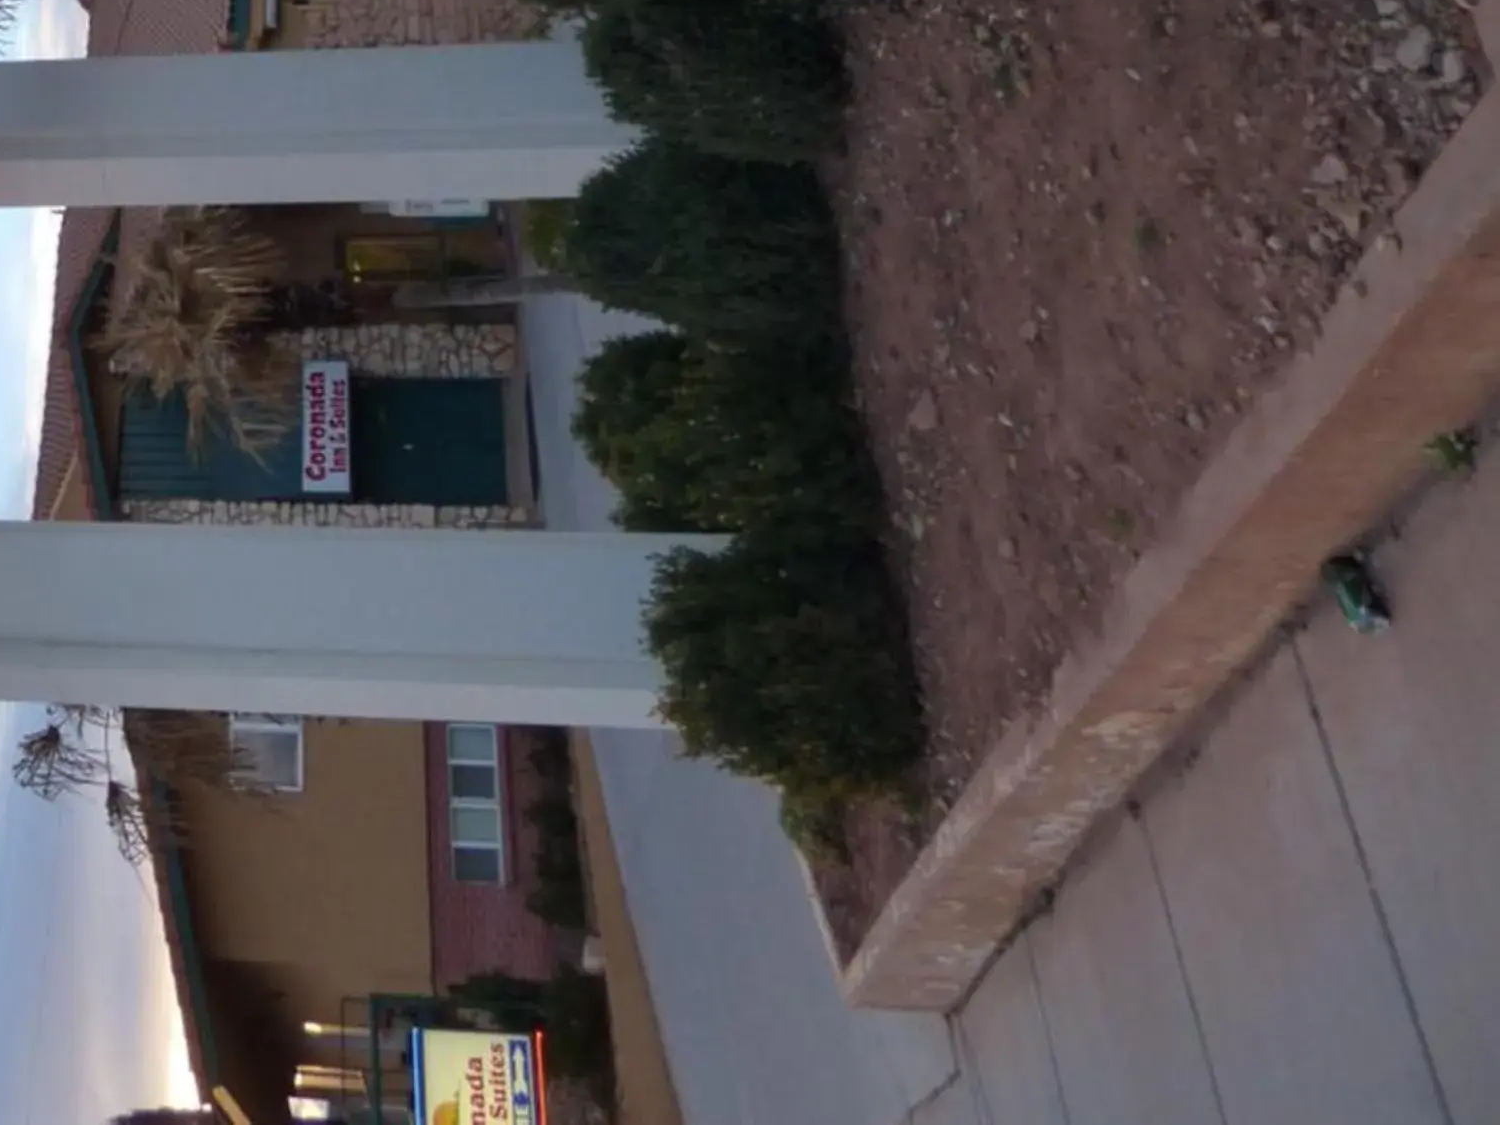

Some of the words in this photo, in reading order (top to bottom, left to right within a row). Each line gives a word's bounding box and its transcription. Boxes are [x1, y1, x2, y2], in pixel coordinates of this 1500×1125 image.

[305, 372, 327, 482] Coronada
[329, 378, 346, 429] Suites
[329, 447, 347, 474] Inn
[489, 1042, 508, 1121] Suites
